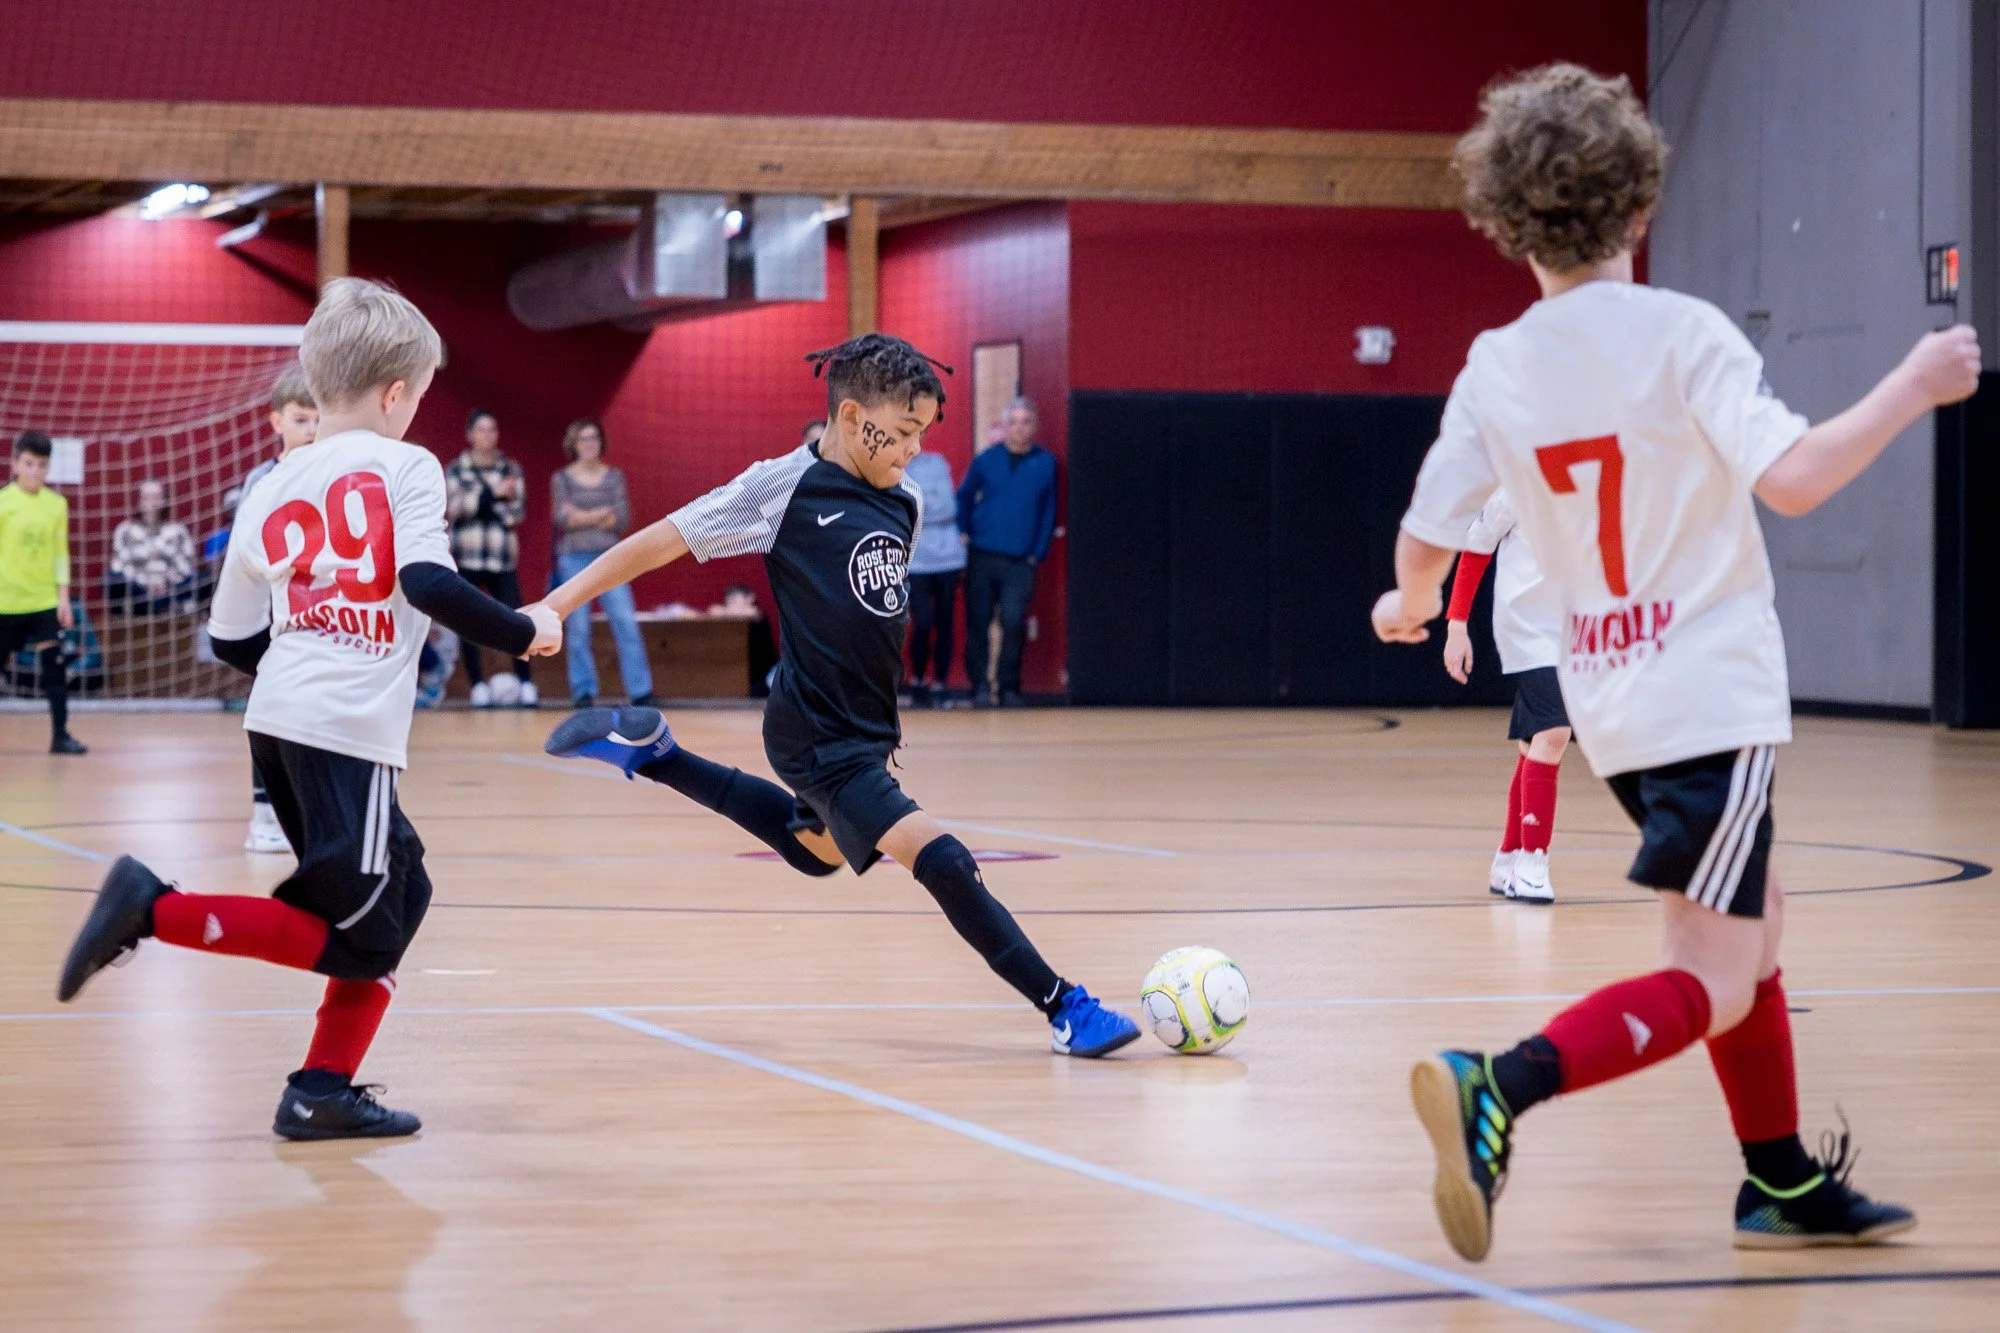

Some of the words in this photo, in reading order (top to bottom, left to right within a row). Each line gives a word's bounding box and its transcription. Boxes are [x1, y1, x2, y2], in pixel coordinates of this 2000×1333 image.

[862, 420, 897, 449] RCF
[262, 471, 396, 616] 29
[1534, 432, 1628, 598] 7
[856, 549, 884, 572] ROSE
[886, 548, 903, 565] CITY
